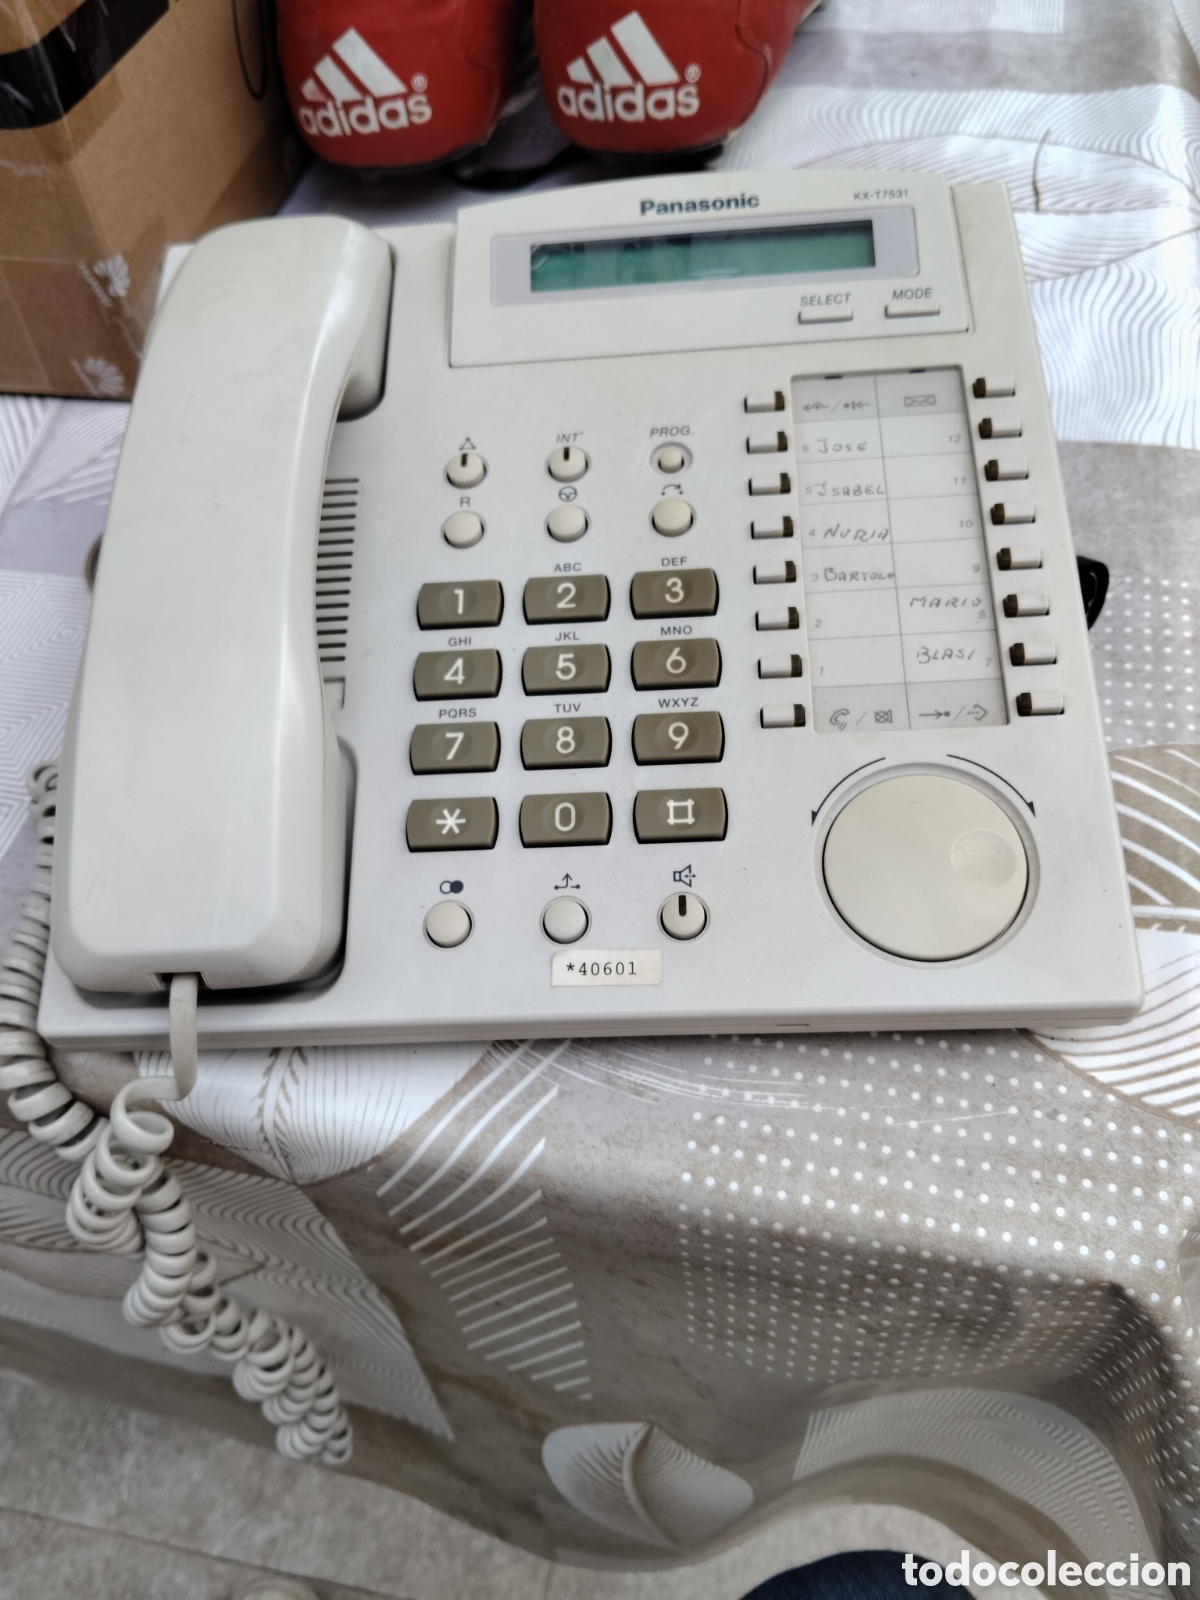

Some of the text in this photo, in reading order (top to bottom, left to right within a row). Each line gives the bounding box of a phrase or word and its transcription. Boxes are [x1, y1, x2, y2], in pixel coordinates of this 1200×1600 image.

[557, 76, 700, 122] adidas
[300, 90, 433, 138] adidas
[853, 189, 908, 201] KX-T7531
[640, 192, 760, 217] Panasonic
[799, 292, 852, 308] SELECT
[891, 287, 933, 301] MODE
[650, 425, 694, 438] PROG.
[948, 434, 962, 444] 12
[953, 476, 966, 486] 11
[805, 485, 812, 495] 5
[459, 496, 471, 508] R
[959, 519, 973, 529] 10
[808, 523, 890, 543] 4 NURIA
[554, 562, 582, 573] ABC
[661, 556, 688, 568] DEF
[972, 564, 980, 574] 9
[811, 573, 819, 583] 3
[556, 582, 577, 609] 2
[664, 577, 685, 603] 3
[454, 588, 465, 615] 1
[909, 595, 982, 608] MARIO
[978, 609, 986, 620] 8
[814, 619, 822, 629] 2
[660, 625, 693, 636] MNO
[448, 637, 472, 647] GHI
[555, 632, 580, 642] JKL
[555, 653, 576, 680] 5
[666, 647, 687, 674] 6
[985, 657, 992, 668] 7
[444, 657, 465, 685] 4
[554, 703, 582, 713] TUV
[658, 697, 699, 708] WXYZ
[439, 708, 477, 719] PQRS
[555, 726, 576, 754] 8
[668, 722, 689, 750] 9
[445, 732, 465, 760] 7
[555, 802, 576, 832] 0
